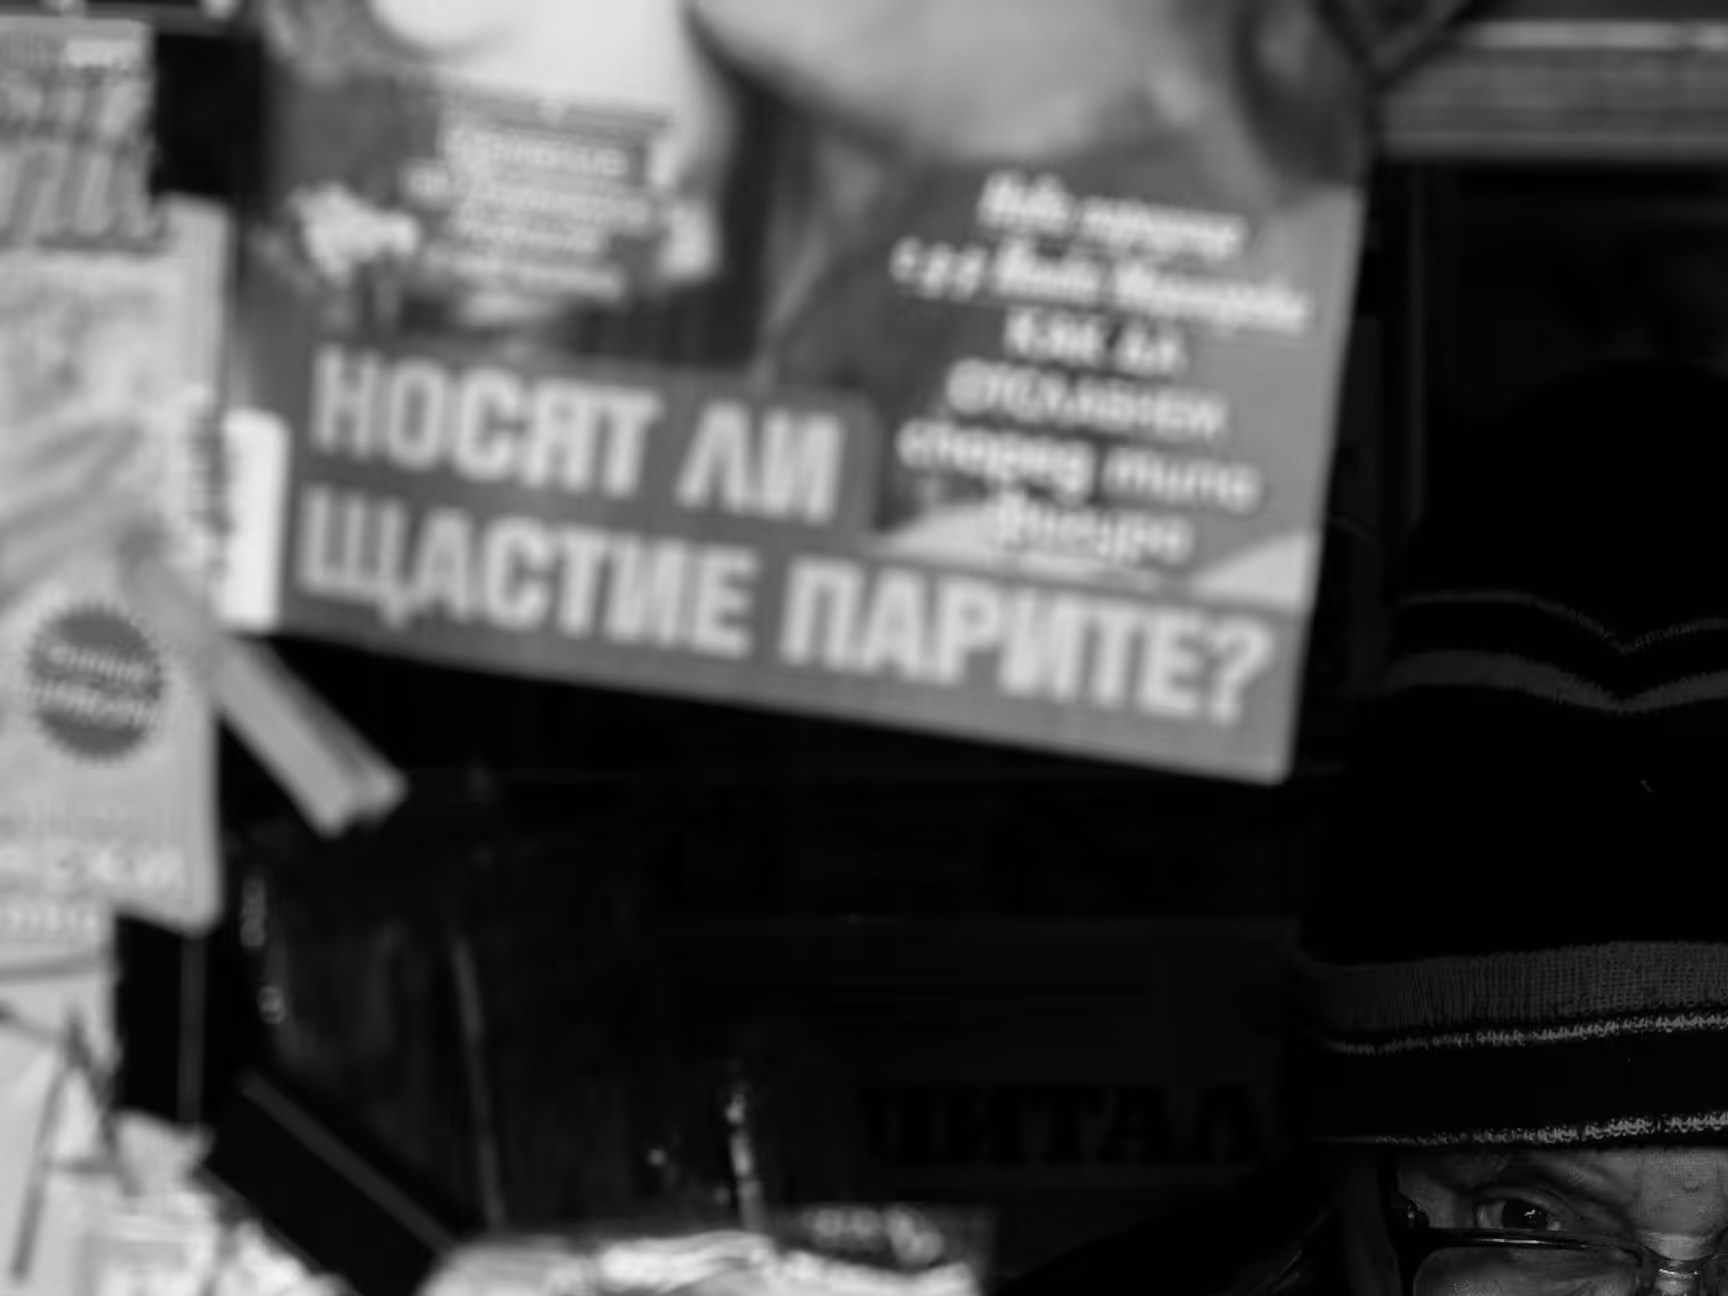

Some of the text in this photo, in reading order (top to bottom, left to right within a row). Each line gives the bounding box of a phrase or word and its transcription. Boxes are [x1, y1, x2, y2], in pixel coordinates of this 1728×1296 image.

[314, 345, 846, 523] НОСЯТ ЛИ
[297, 486, 1276, 727] ЩАСТИЕ ПАРИТЕ?
